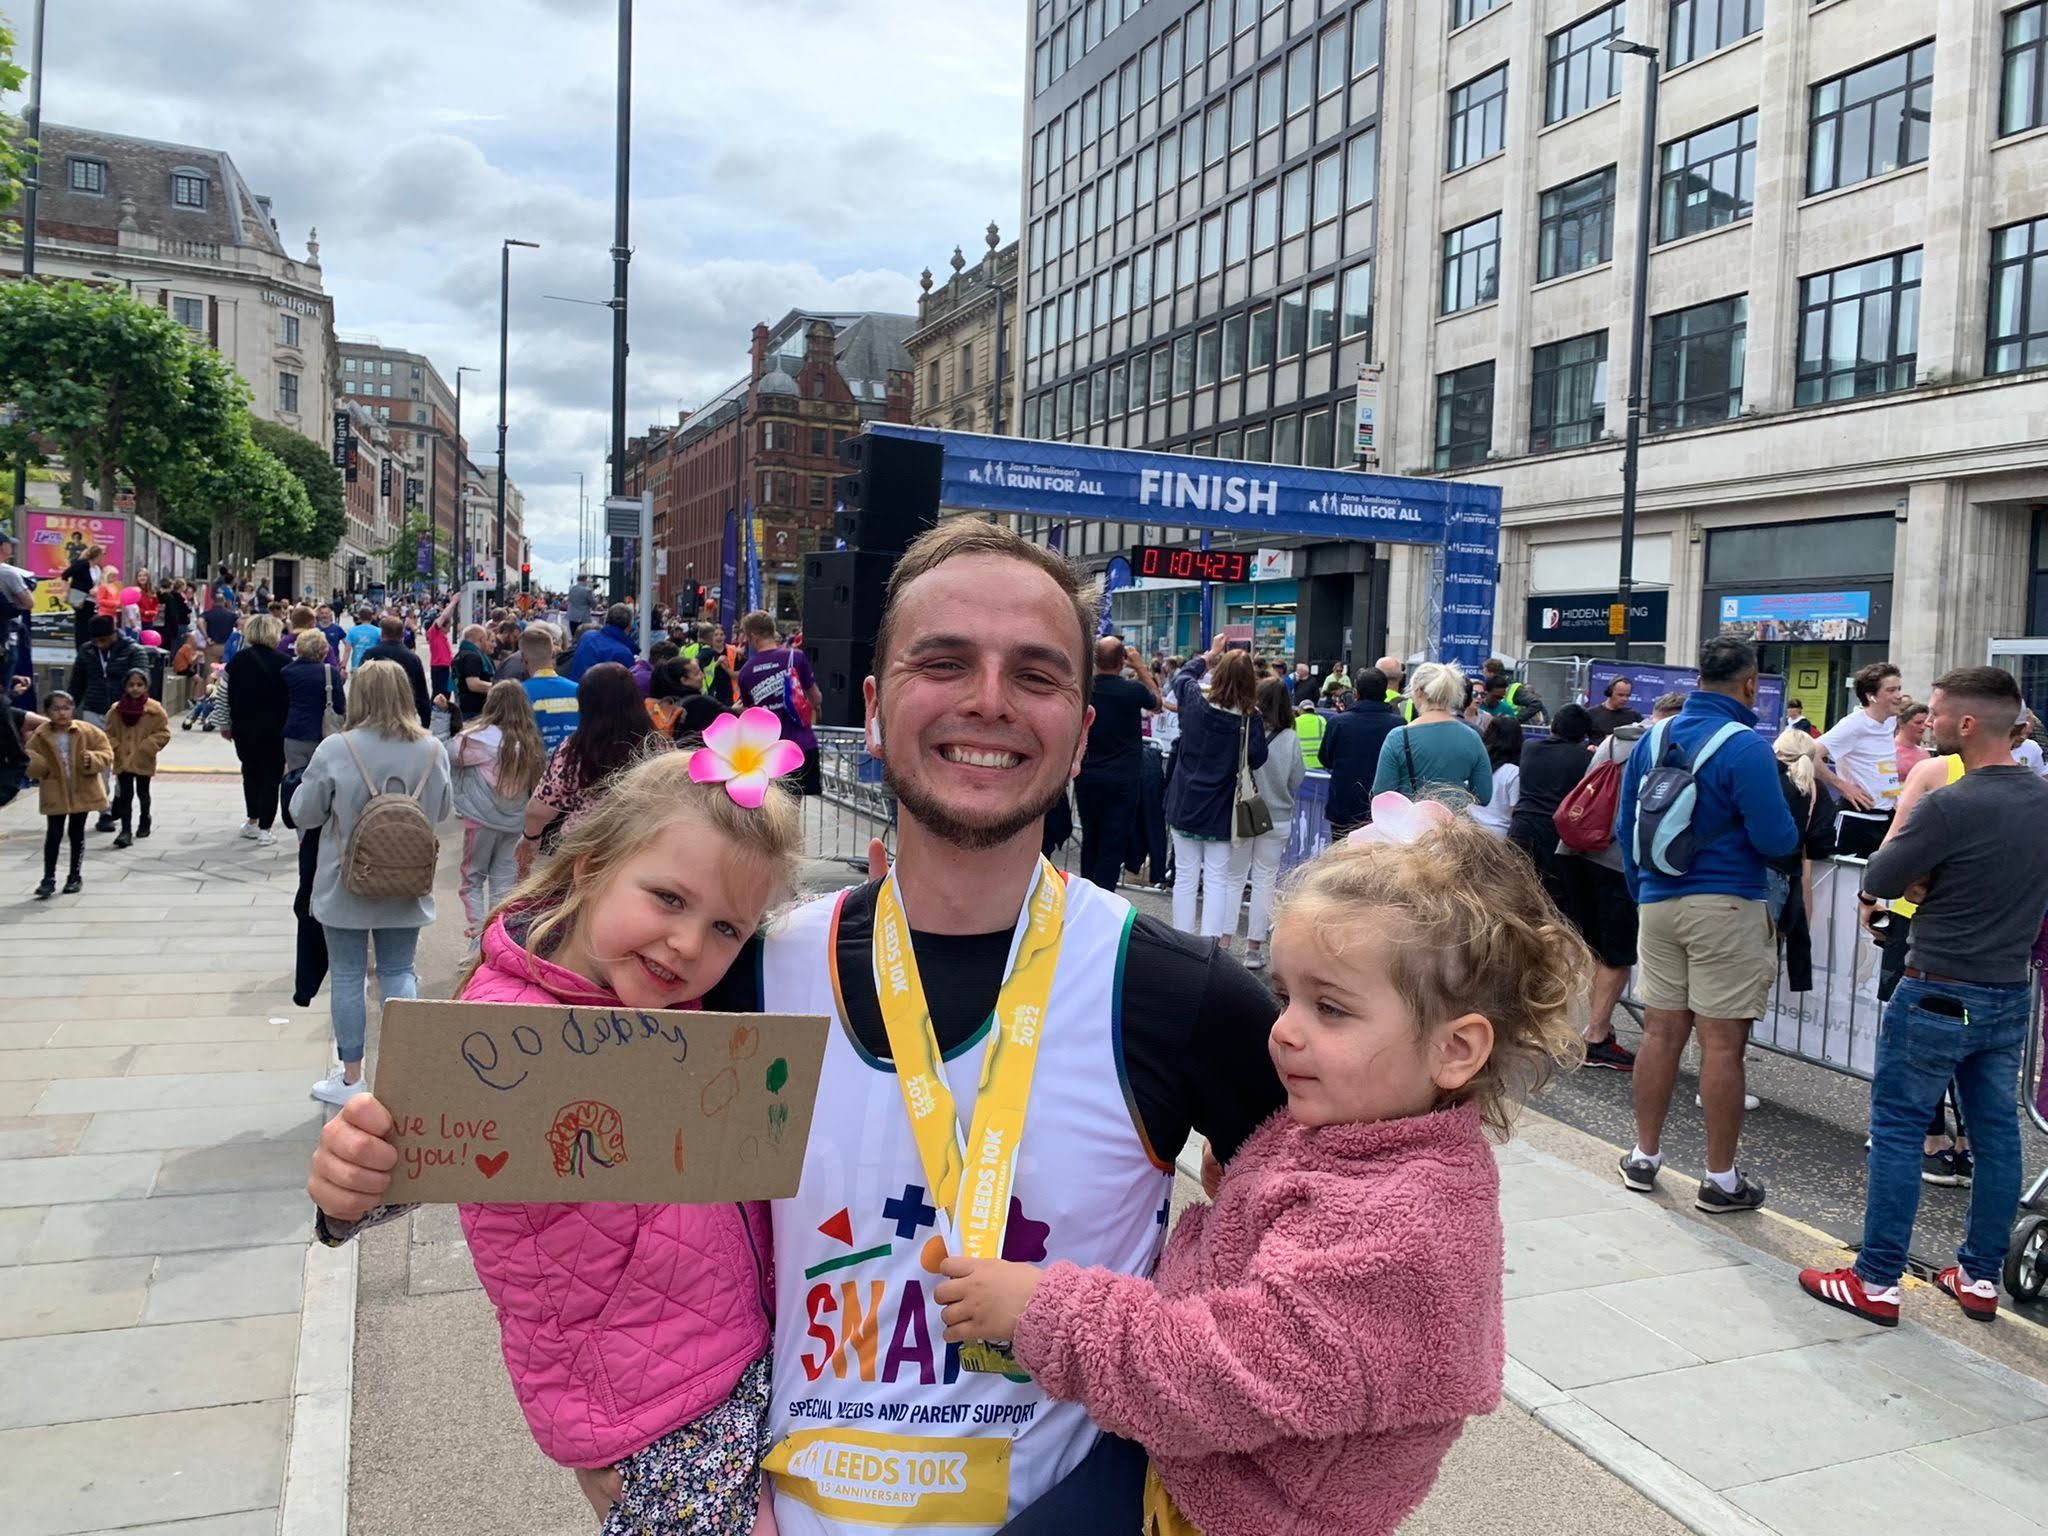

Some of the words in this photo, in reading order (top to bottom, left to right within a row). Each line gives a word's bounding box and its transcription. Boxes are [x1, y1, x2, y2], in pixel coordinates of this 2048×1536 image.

[337, 418, 347, 444] light
[1009, 463, 1030, 472] Jane
[1032, 464, 1080, 477] Tomlinson's
[1008, 474, 1040, 490] RUN
[1044, 477, 1074, 492] FOR
[1078, 481, 1104, 496] ALL
[1140, 469, 1278, 515] FINISH
[1340, 504, 1368, 517] RUN
[1371, 506, 1396, 519] FOR
[1399, 508, 1422, 521] ALL
[1342, 494, 1360, 502] Jane
[1361, 495, 1401, 505] Tomlinson's
[46, 516, 102, 531] DISCO
[1562, 608, 1599, 618] HIDDEN
[1602, 607, 1648, 618] HING
[884, 912, 902, 962] LEEDS
[890, 961, 909, 996] 10K
[1020, 1006, 1040, 1048] 2022
[906, 1076, 928, 1119] 2022
[441, 1113, 500, 1140] love
[981, 1128, 1004, 1164] 10K
[405, 1142, 468, 1180] you!
[970, 1168, 996, 1230] LEEDS
[790, 1398, 833, 1420] SPECIAL
[878, 1404, 910, 1422] AND
[910, 1404, 972, 1424] PARENT
[972, 1401, 1038, 1424] SUPPORT
[822, 1450, 900, 1486] LEEDS
[906, 1458, 962, 1486] 10K
[820, 1482, 832, 1492] 15
[835, 1486, 917, 1503] ANNIVERSARY
